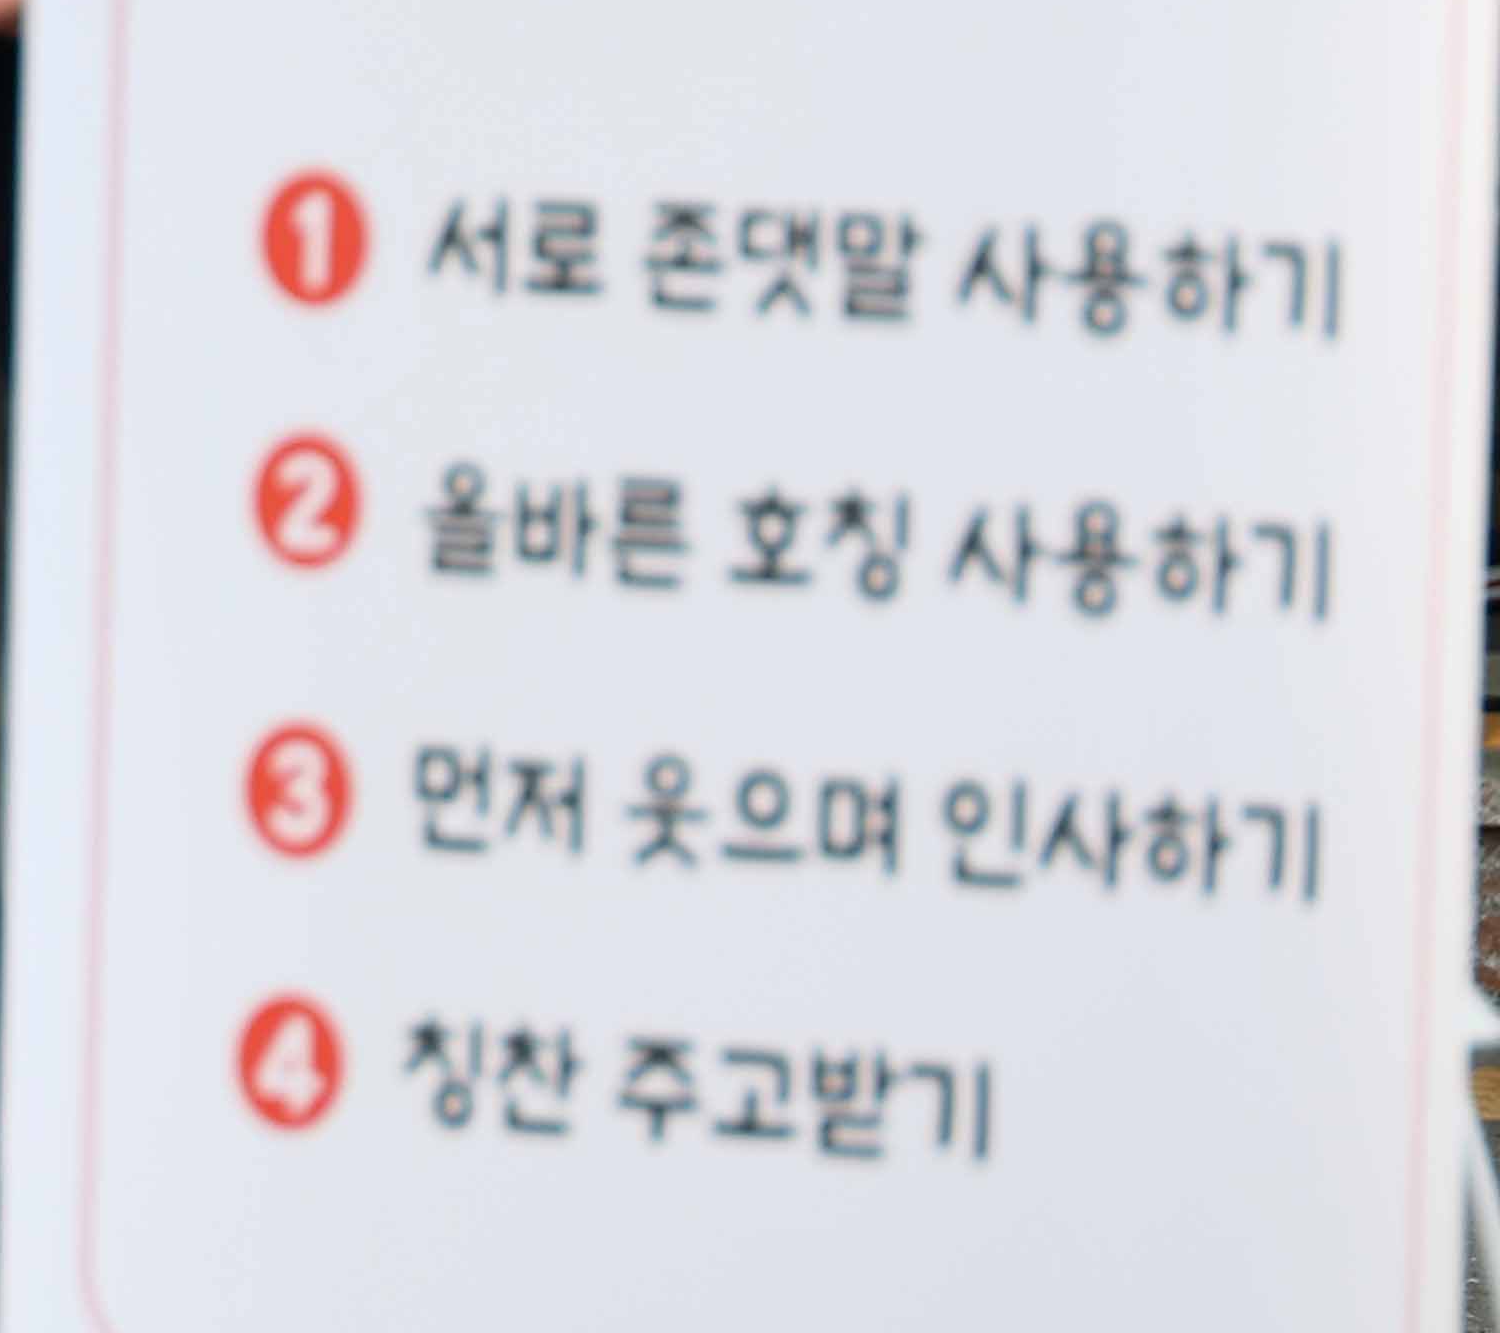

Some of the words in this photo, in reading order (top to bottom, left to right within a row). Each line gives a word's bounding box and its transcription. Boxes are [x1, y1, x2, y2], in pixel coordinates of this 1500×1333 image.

[425, 197, 607, 301] 서로
[640, 200, 926, 326] 존댓말
[954, 219, 1346, 343] 사용하기
[422, 460, 692, 591] 올바른
[728, 485, 913, 605] 호칭
[946, 498, 1335, 626] 사용하기
[412, 743, 588, 855] 먼저
[622, 755, 902, 874] 웃으며
[940, 775, 1324, 906] 인사하기
[405, 1015, 582, 1137] 칭찬
[616, 1035, 995, 1165] 주고받기
